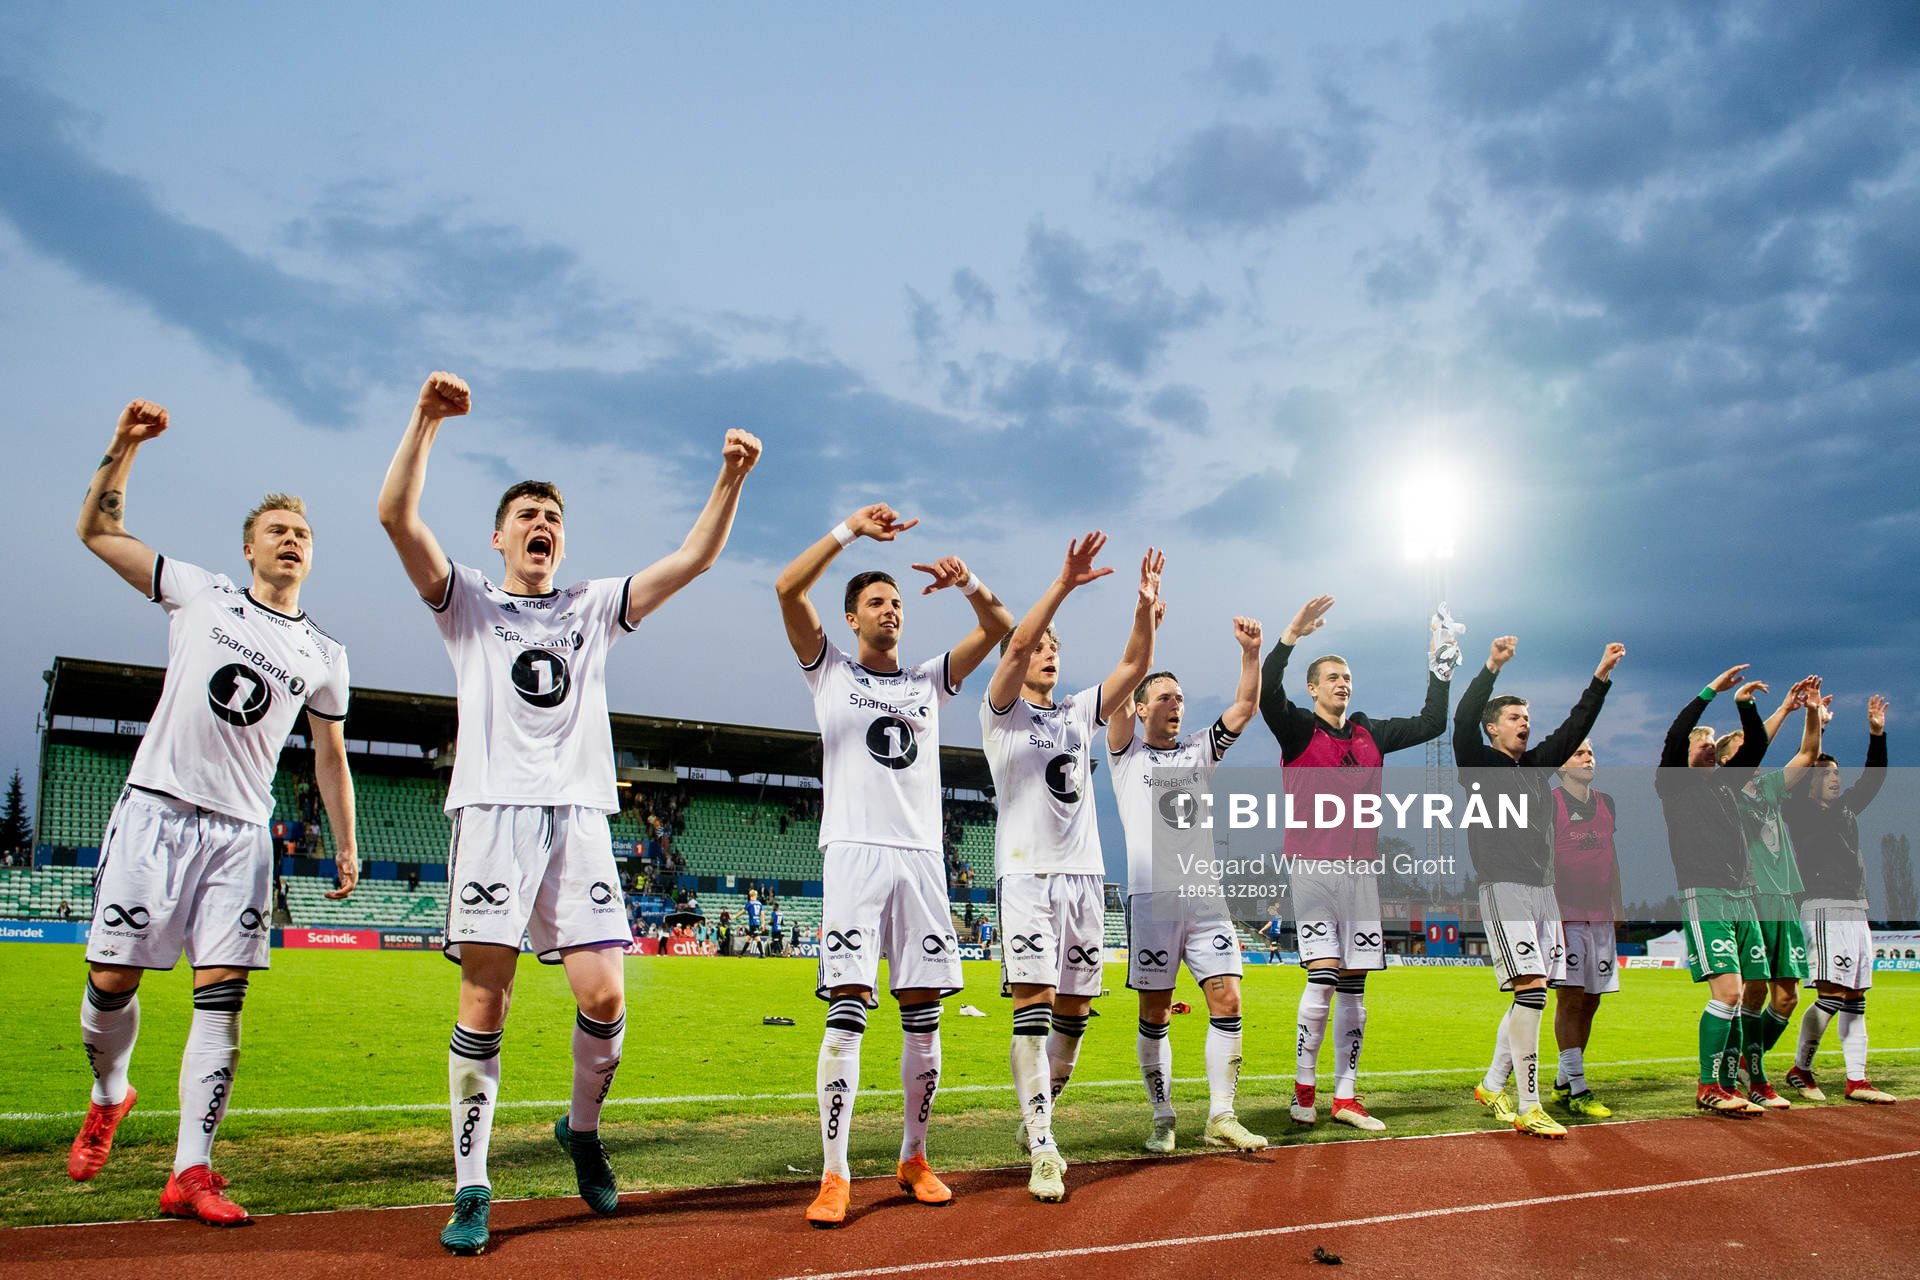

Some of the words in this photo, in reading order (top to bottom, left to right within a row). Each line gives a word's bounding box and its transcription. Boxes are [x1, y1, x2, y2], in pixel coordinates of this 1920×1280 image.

[209, 627, 290, 684] SpareBank
[1143, 774, 1193, 788] SpareBank
[307, 932, 357, 945] Scandic
[384, 935, 423, 943] SECTOR
[1350, 1040, 1360, 1070] coop
[1528, 1063, 1536, 1094] coop
[203, 1083, 226, 1134] coop
[828, 1093, 844, 1140] coop
[918, 1080, 937, 1123] coop
[460, 1106, 481, 1158] coop
